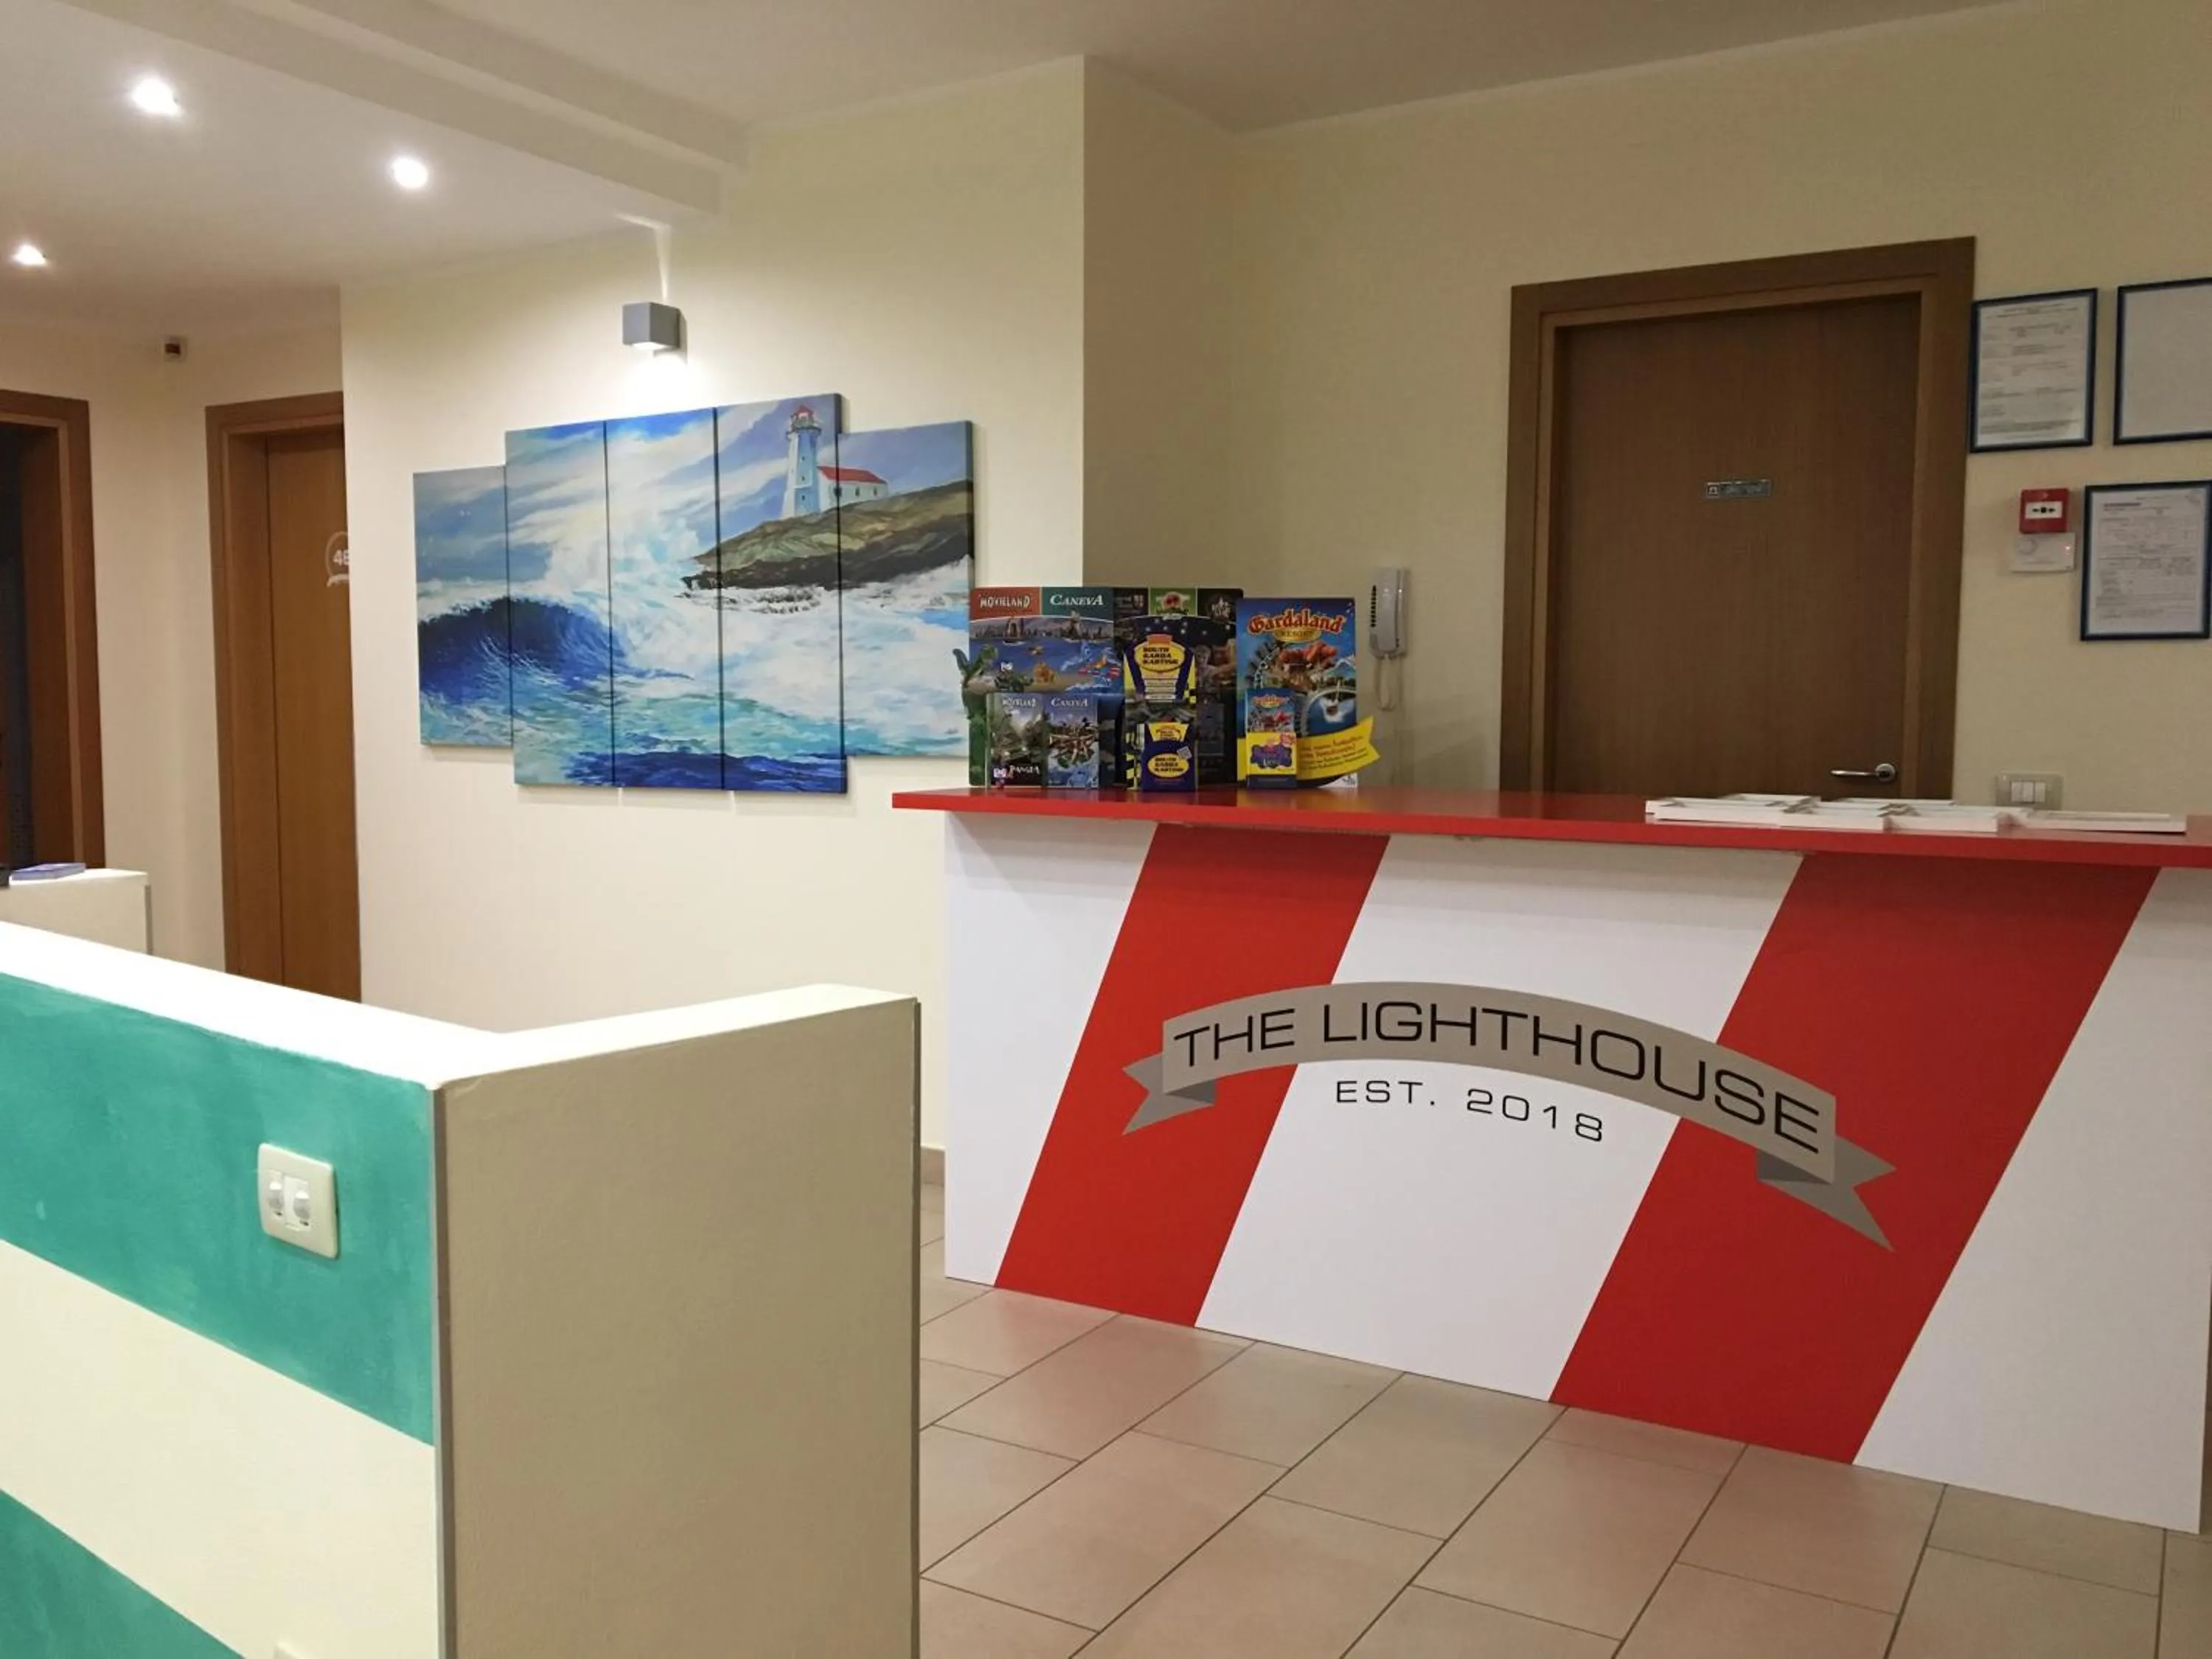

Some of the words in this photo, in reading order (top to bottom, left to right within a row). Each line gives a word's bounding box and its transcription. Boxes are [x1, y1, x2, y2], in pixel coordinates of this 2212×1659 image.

[979, 595, 1031, 608] MOVIELAND
[1049, 594, 1104, 606] CANEVA
[1248, 610, 1345, 633] Gardaland
[1174, 1009, 1295, 1066] THE
[1324, 1001, 1819, 1154] LIGHTHOUSE
[1336, 1080, 1437, 1106] EST.
[1467, 1089, 1604, 1143] 2018
